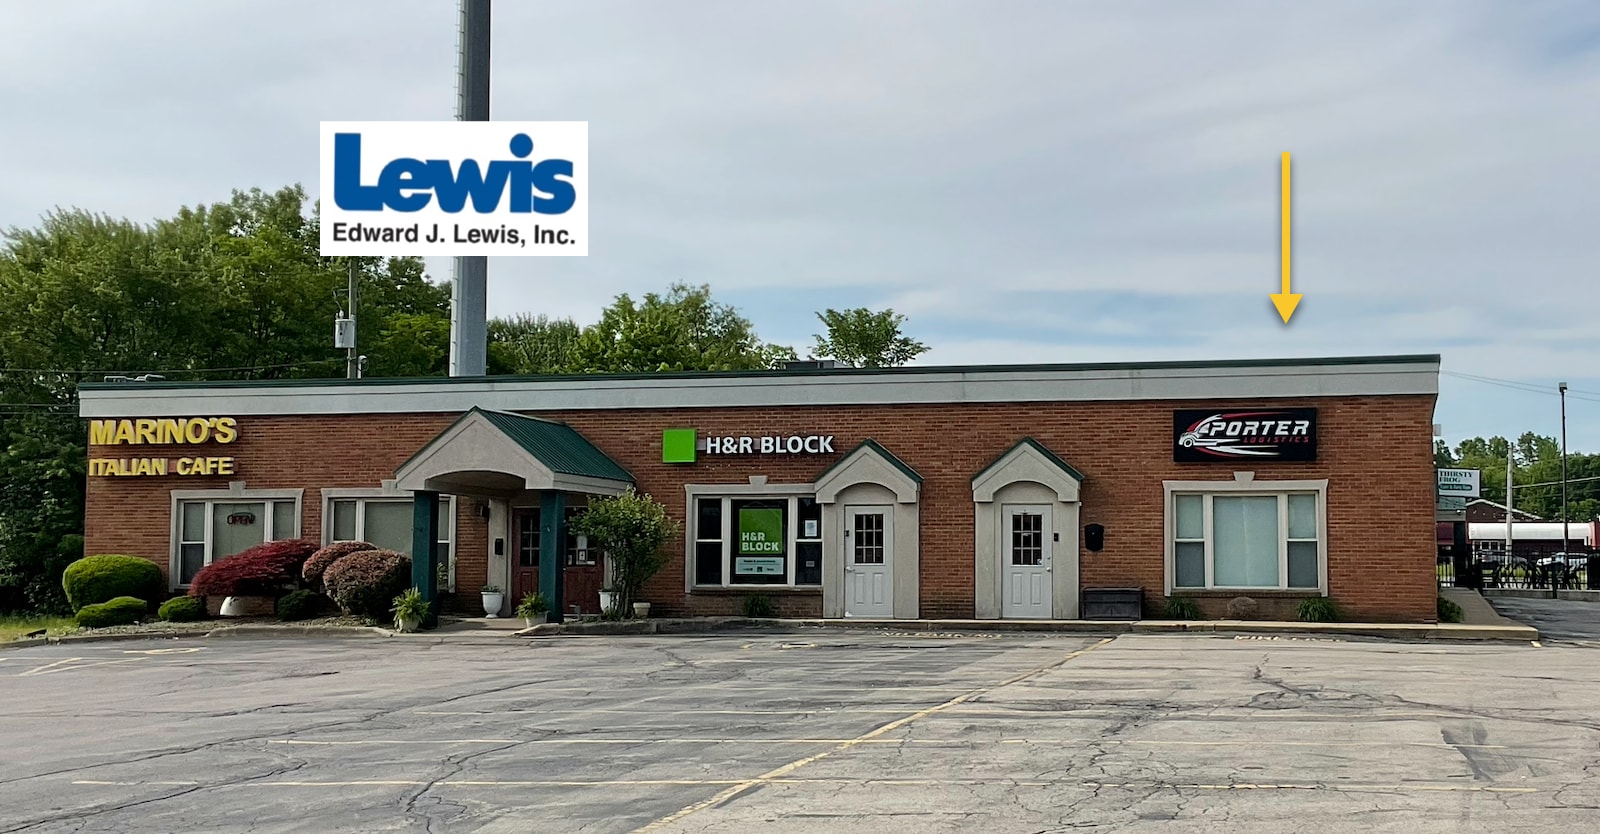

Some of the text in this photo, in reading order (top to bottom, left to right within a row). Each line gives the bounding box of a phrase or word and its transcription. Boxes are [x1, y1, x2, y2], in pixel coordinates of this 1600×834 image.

[89, 417, 238, 446] MARINO'S
[1209, 420, 1309, 436] PORTER
[705, 435, 835, 454] H&R BLOCK
[88, 456, 235, 477] ITALIAN CAFE
[227, 513, 255, 525] OPEN
[742, 532, 765, 541] H&R
[742, 542, 779, 551] BLOCK
